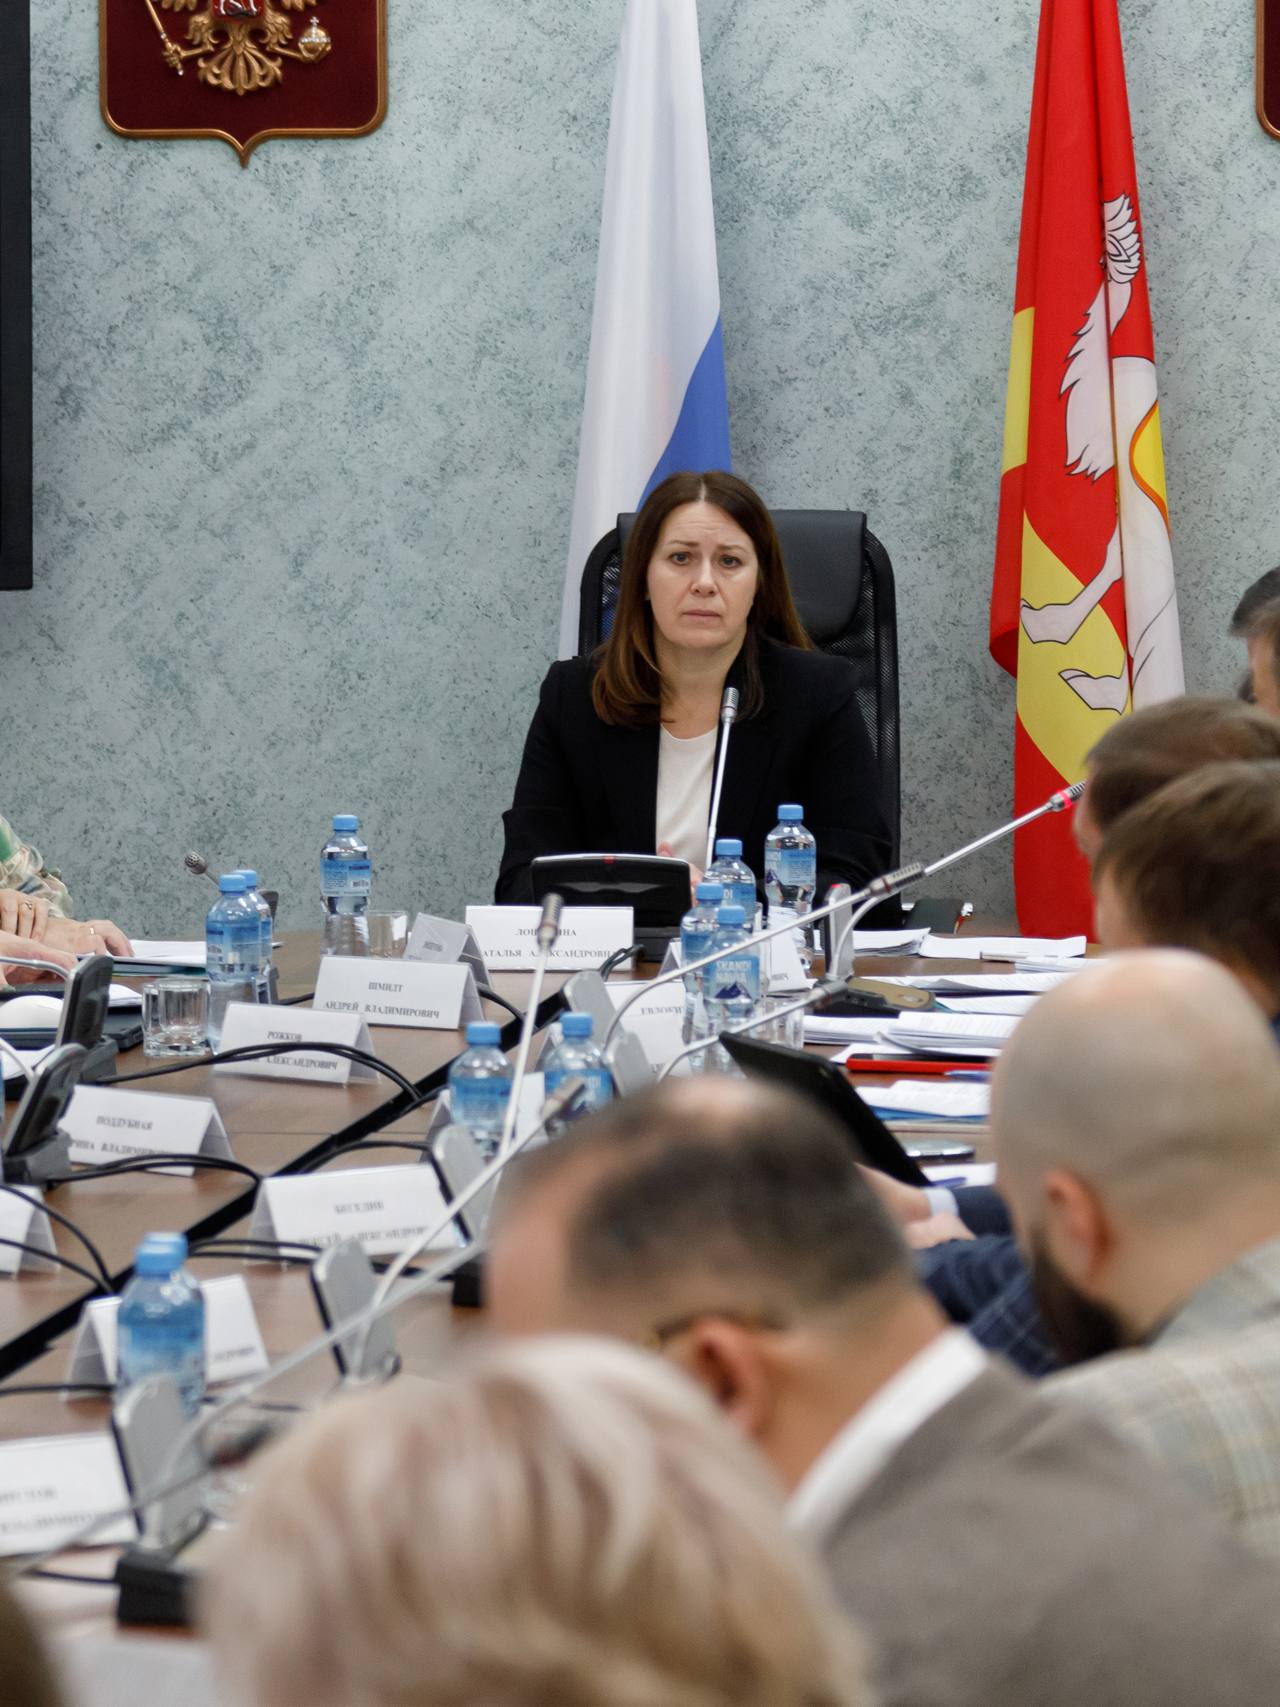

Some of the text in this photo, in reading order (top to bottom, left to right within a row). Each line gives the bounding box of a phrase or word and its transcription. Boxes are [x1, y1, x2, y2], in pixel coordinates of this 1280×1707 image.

[483, 949, 522, 957] АТАЛЬЯ
[324, 1000, 440, 1019] АНДРЕЙ ВЛАДИМИРОВИЧ
